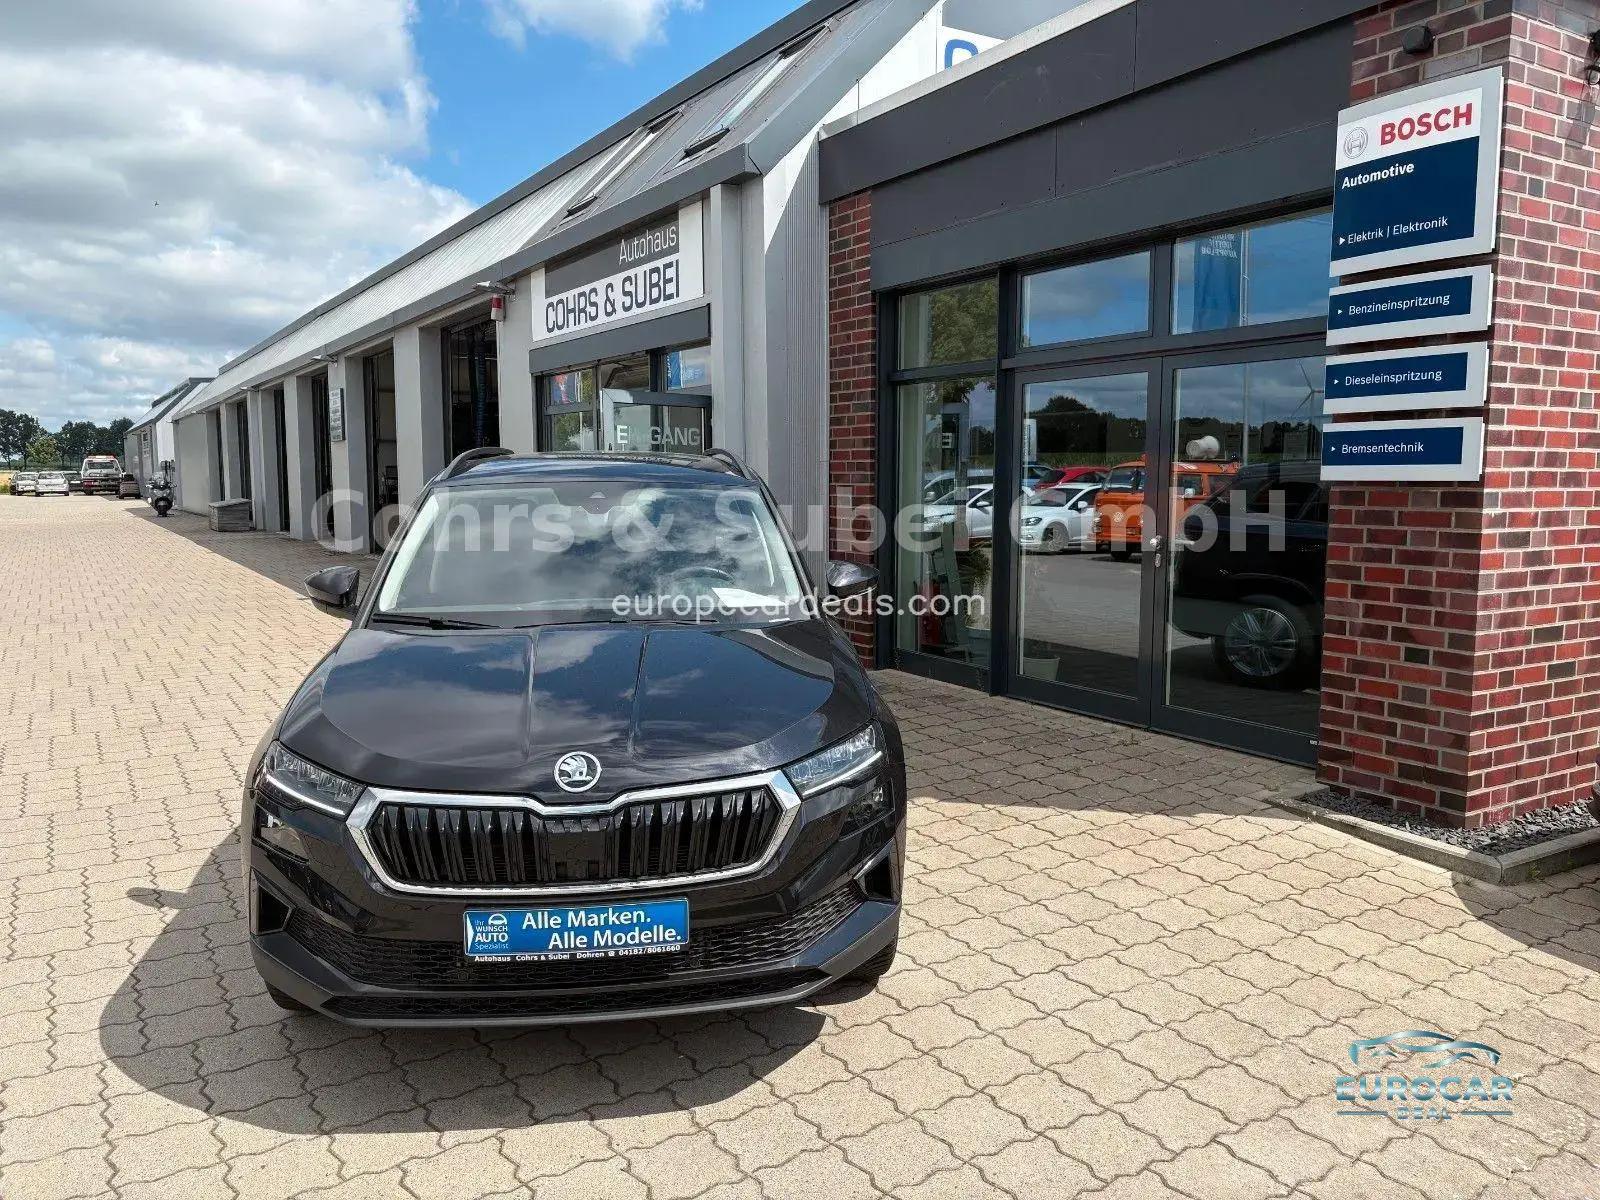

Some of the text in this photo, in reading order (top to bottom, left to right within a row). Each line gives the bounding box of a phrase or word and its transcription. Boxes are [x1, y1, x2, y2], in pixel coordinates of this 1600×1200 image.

[1380, 103, 1473, 146] BOSCH
[1342, 162, 1415, 189] Automotive
[1348, 226, 1384, 244] Elektrik
[1393, 216, 1448, 235] Elektronik
[619, 226, 677, 265] Autohaus
[545, 258, 680, 333] COHRS & SUBEI
[1348, 294, 1450, 315] Benzineinspritzung
[1345, 370, 1442, 386] Dieseleinspritzung
[616, 424, 700, 446] EIGANG
[1341, 442, 1424, 454] Bremsentechnik
[522, 907, 651, 930] Alle Marken.
[475, 932, 509, 943] AUTO
[475, 942, 509, 950] Spezialist
[548, 924, 682, 950] Alle Modelle.
[576, 951, 605, 959] Dohren
